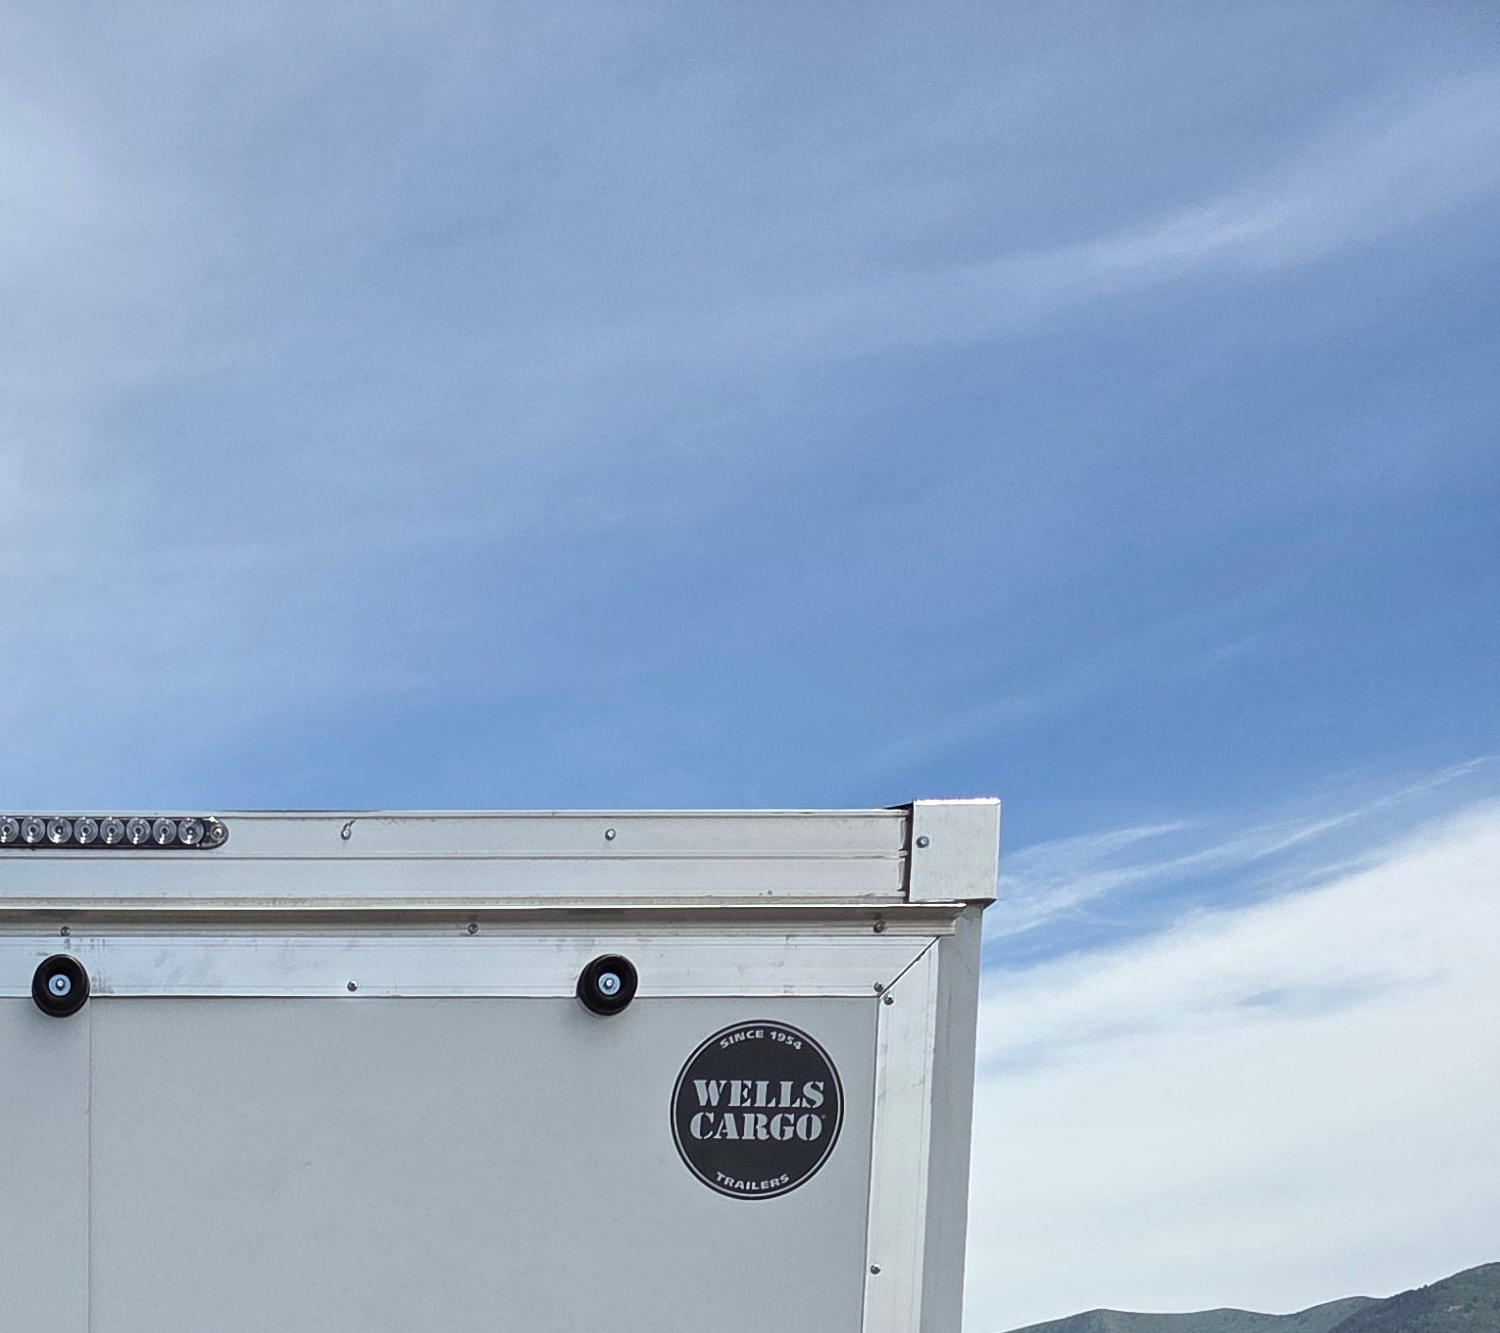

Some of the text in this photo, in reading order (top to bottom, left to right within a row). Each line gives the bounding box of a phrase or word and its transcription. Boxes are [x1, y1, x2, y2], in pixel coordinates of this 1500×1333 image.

[720, 1030, 802, 1050] SINCE 1954
[693, 1079, 825, 1109] WELLS
[690, 1112, 823, 1141] CARGO
[716, 1172, 790, 1190] TRAILERS
